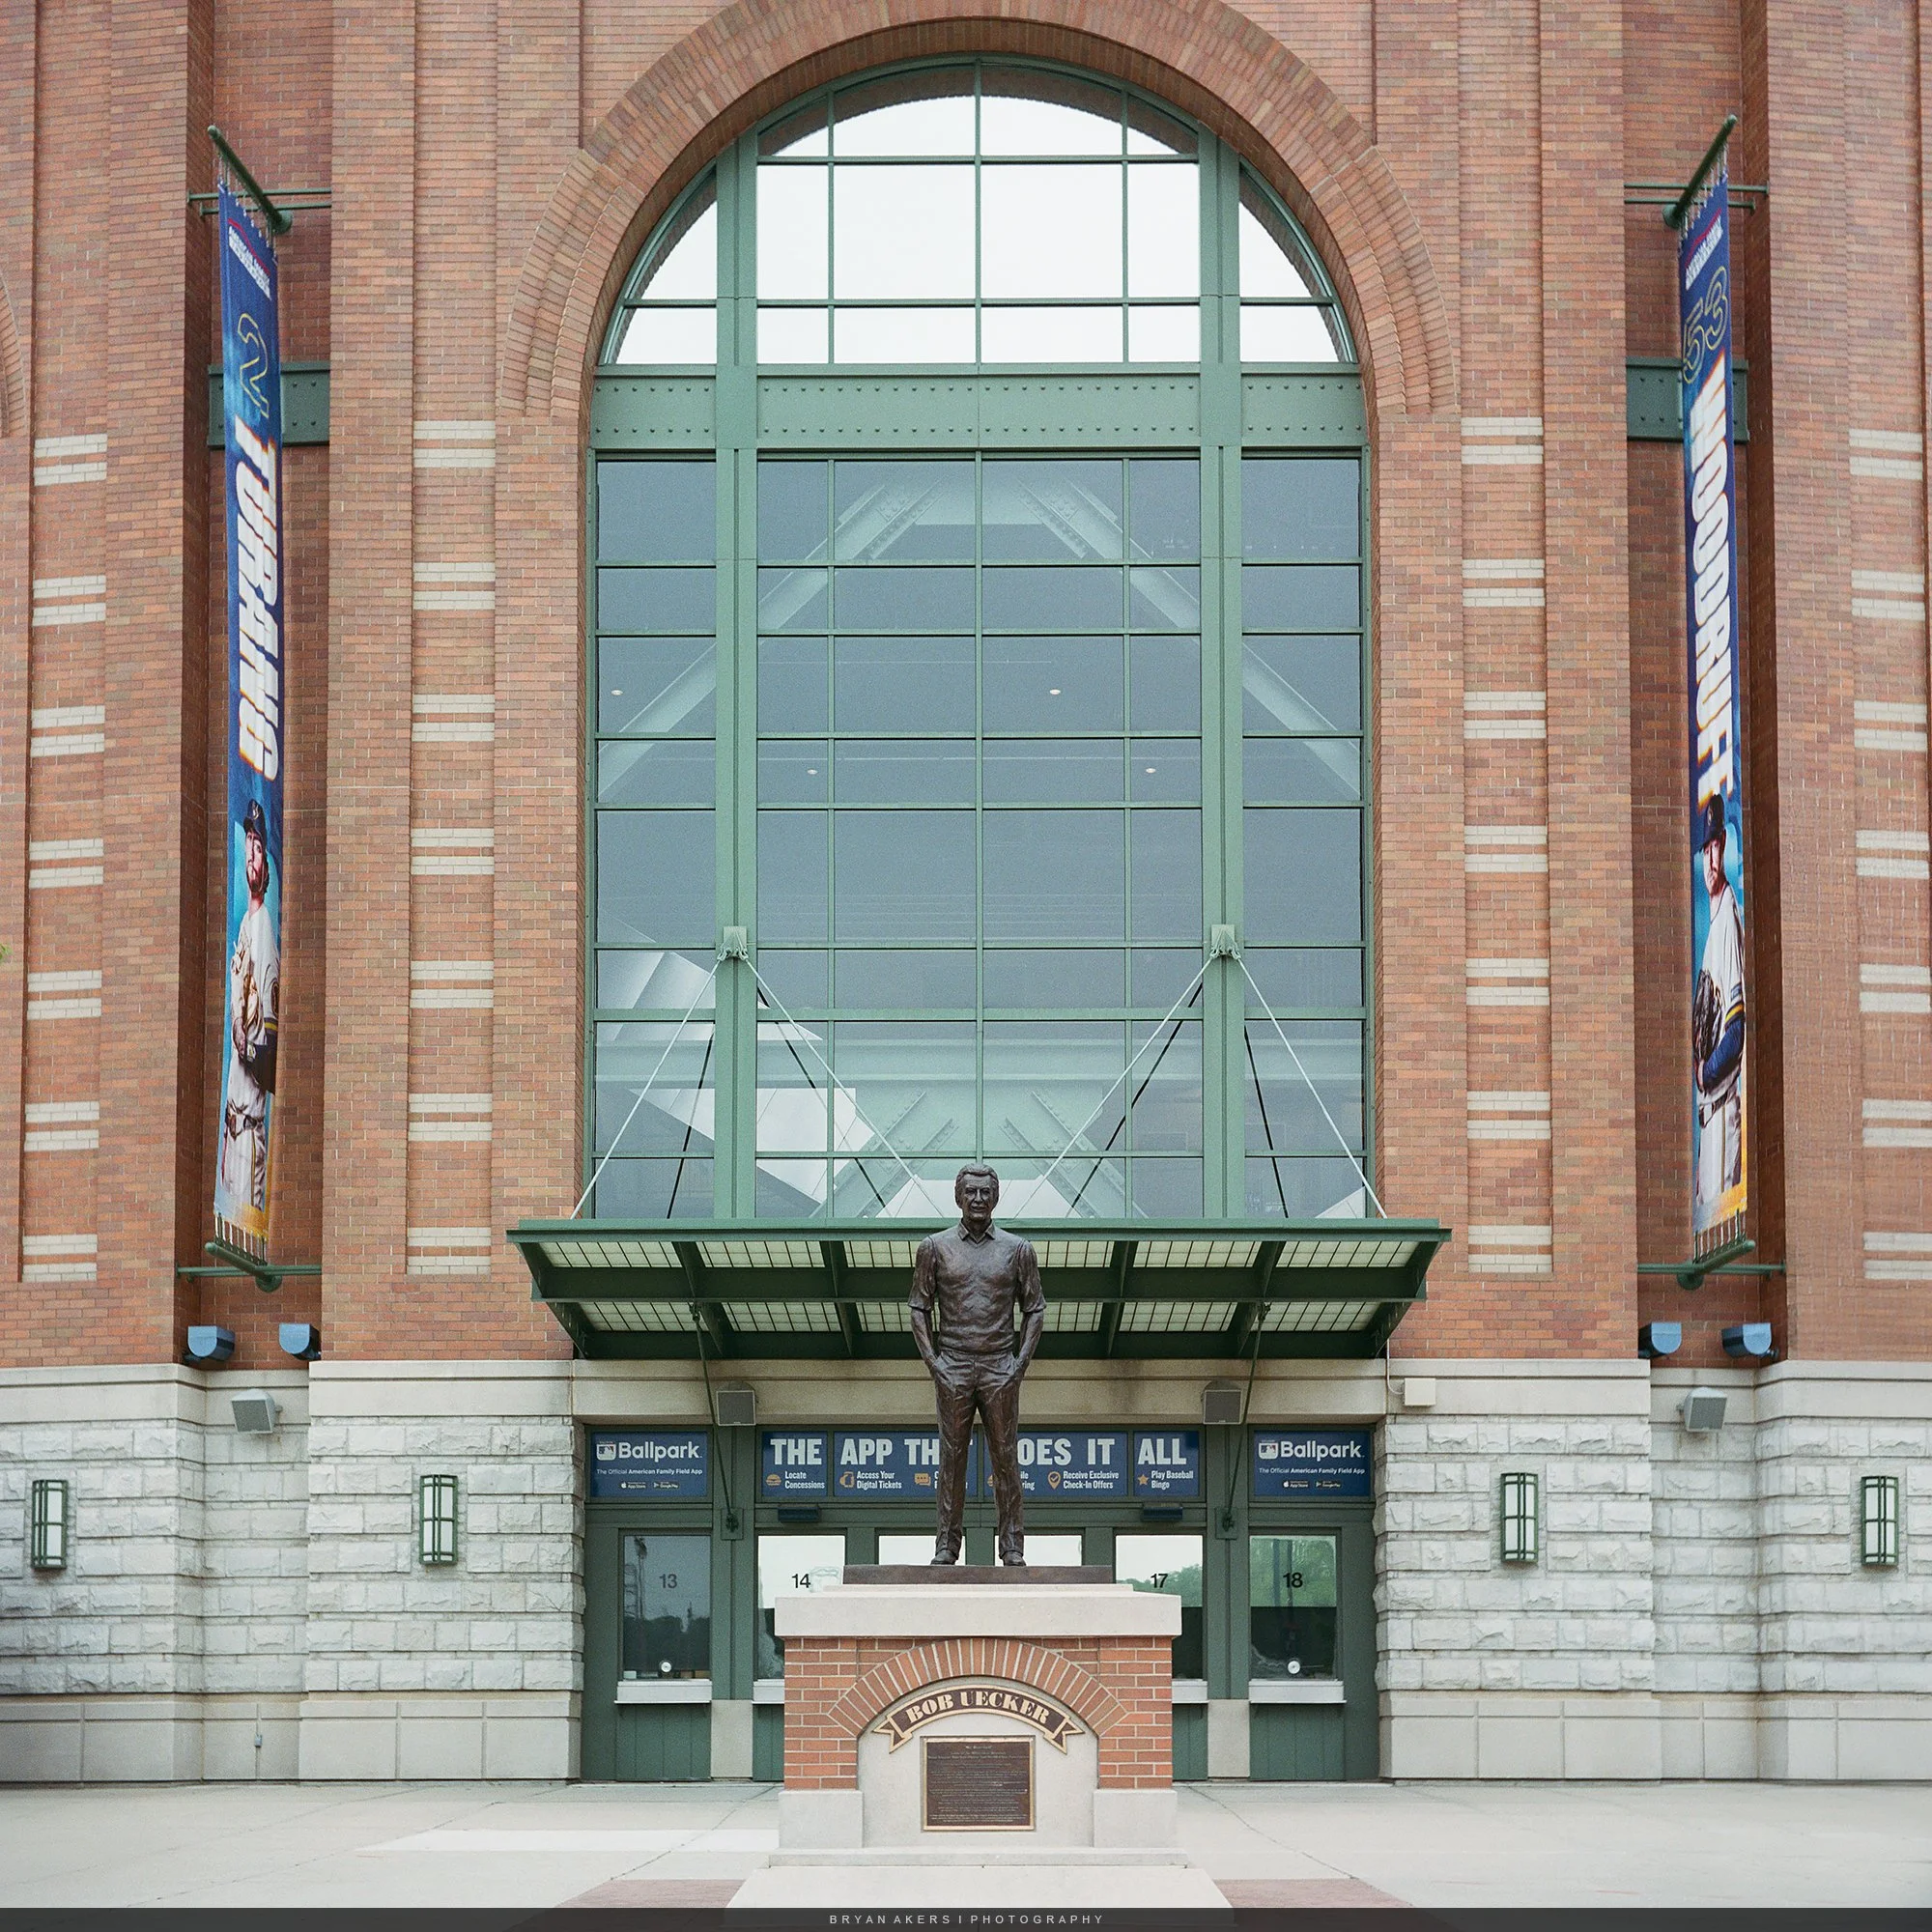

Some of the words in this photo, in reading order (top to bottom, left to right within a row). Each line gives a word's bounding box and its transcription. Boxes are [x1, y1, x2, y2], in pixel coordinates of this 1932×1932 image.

[1683, 266, 1728, 384] 53
[237, 313, 270, 419] 2
[1690, 348, 1734, 813] WOODRUFF
[235, 412, 278, 781] TURANG
[618, 1441, 700, 1463] Ballpark
[770, 1438, 822, 1465] THE
[839, 1438, 894, 1465] APP
[1016, 1437, 1072, 1466] OES
[1087, 1438, 1116, 1465] IT
[1137, 1437, 1187, 1465] ALL
[1280, 1440, 1362, 1463] Ballpark
[784, 1470, 807, 1480] Locate
[856, 1470, 879, 1480] Access
[880, 1470, 895, 1480] Your
[1063, 1470, 1089, 1479] Receive
[1089, 1470, 1120, 1479] Exclusive
[1151, 1470, 1165, 1481] Play
[1166, 1470, 1194, 1479] Baseball
[856, 1480, 877, 1491] Digital
[878, 1480, 902, 1489] Tickets
[1063, 1480, 1092, 1489] Check-In
[1093, 1480, 1114, 1489] Offers
[1151, 1480, 1170, 1491] Bingo
[659, 1574, 678, 1589] 13
[791, 1574, 811, 1589] 14
[1151, 1573, 1169, 1589] 17
[1283, 1572, 1304, 1589] 18
[904, 1694, 954, 1724] BOB
[959, 1690, 1050, 1725] UECKER
